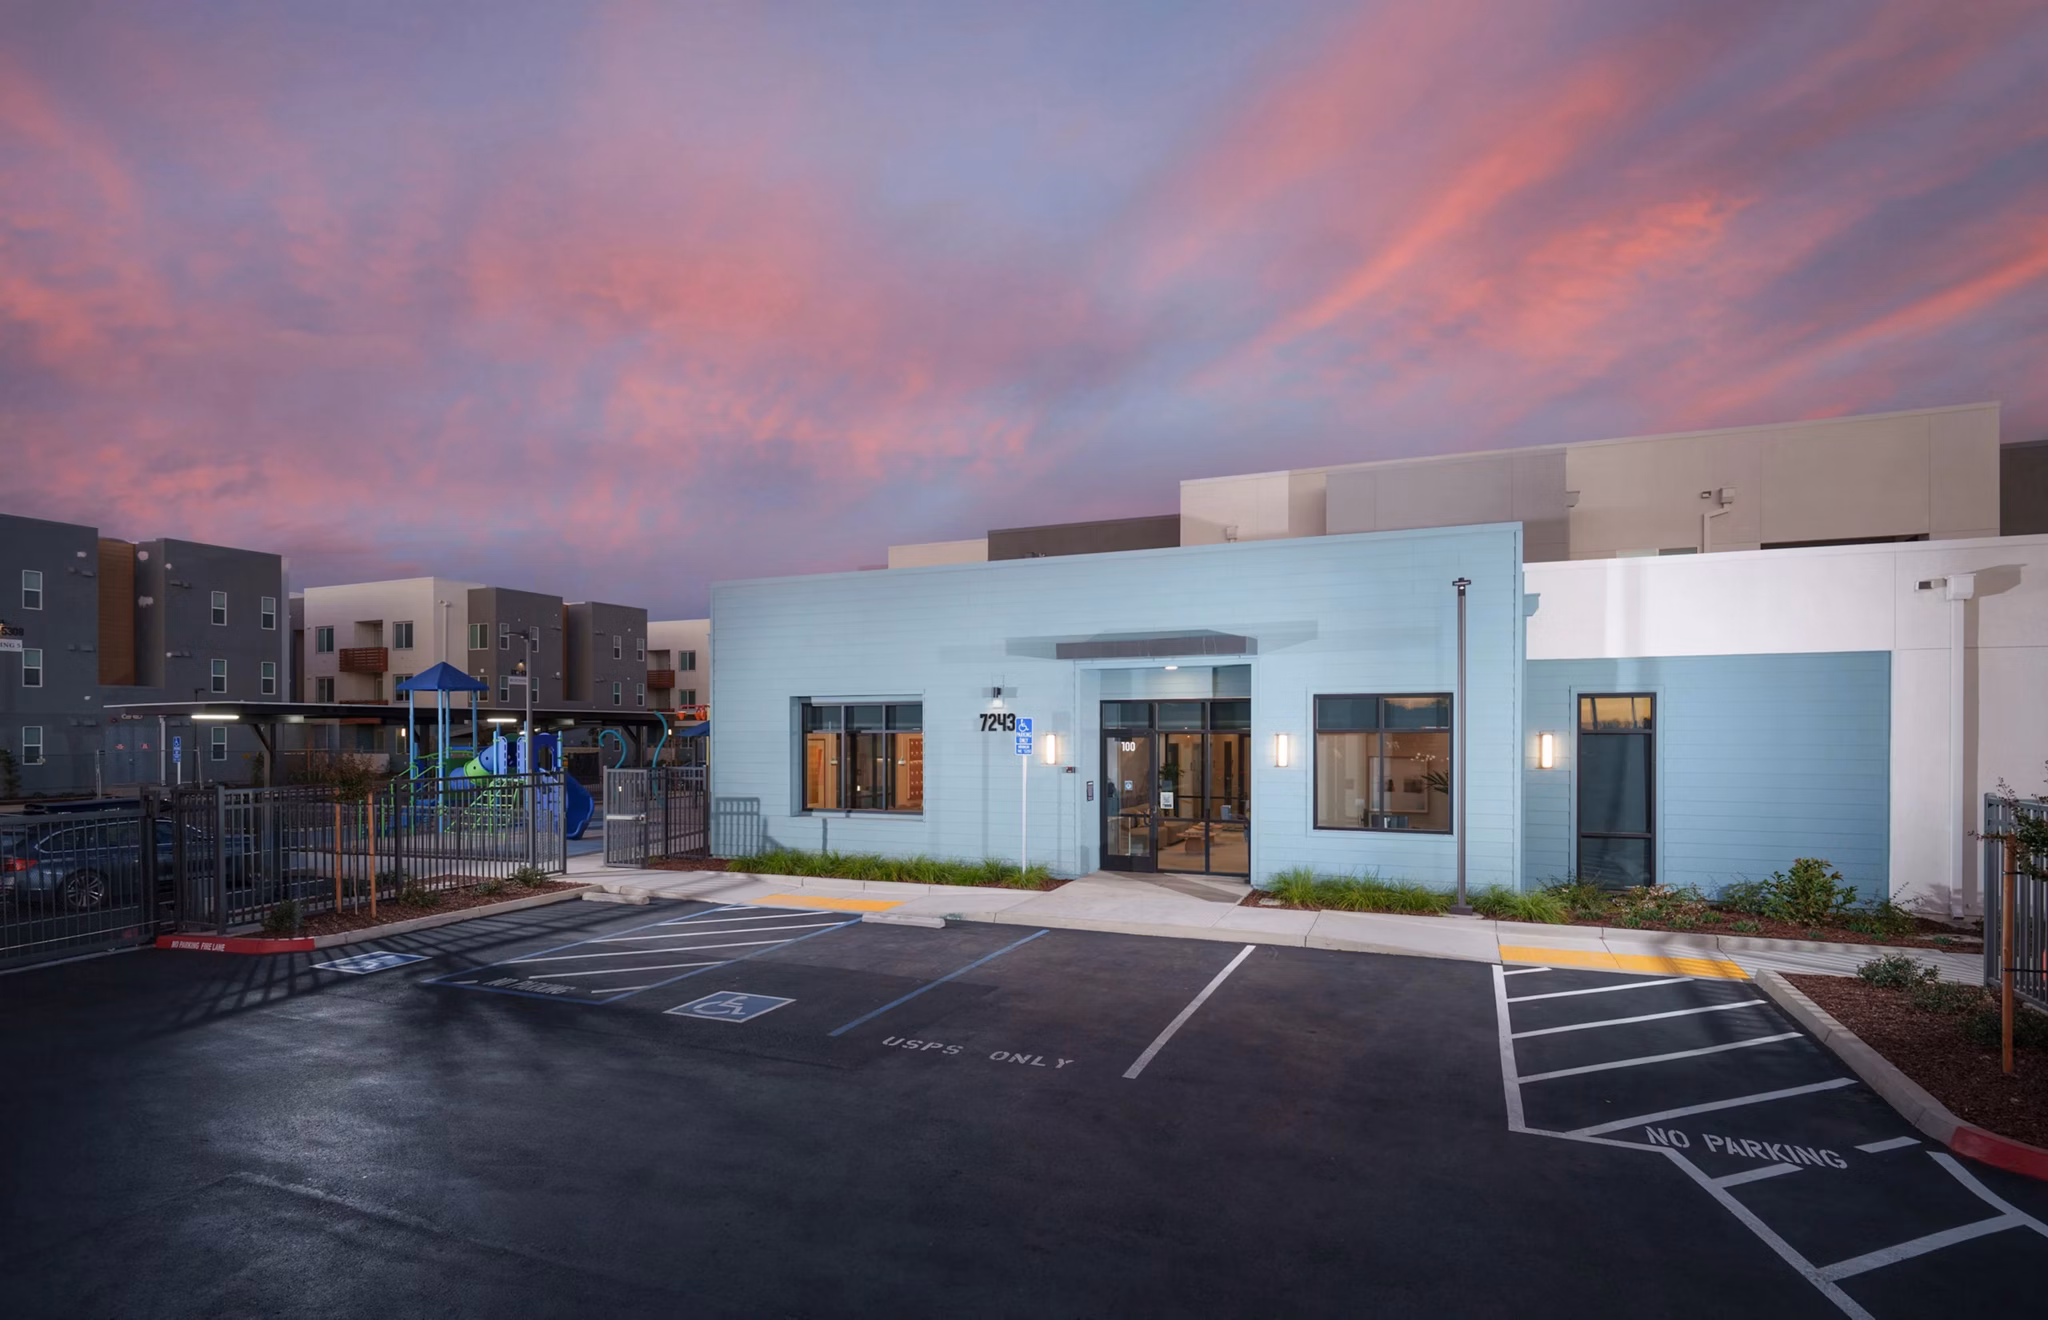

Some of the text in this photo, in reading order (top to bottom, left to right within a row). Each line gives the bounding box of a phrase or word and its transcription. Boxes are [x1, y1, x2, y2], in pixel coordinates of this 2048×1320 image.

[979, 713, 1016, 732] 7243
[1121, 741, 1136, 752] 100
[171, 940, 226, 952] NO PARKING FIRE LANE
[482, 977, 577, 995] NO PARKING
[882, 1036, 1075, 1069] USPS ONLY
[1644, 1125, 1848, 1170] NO PARKING
